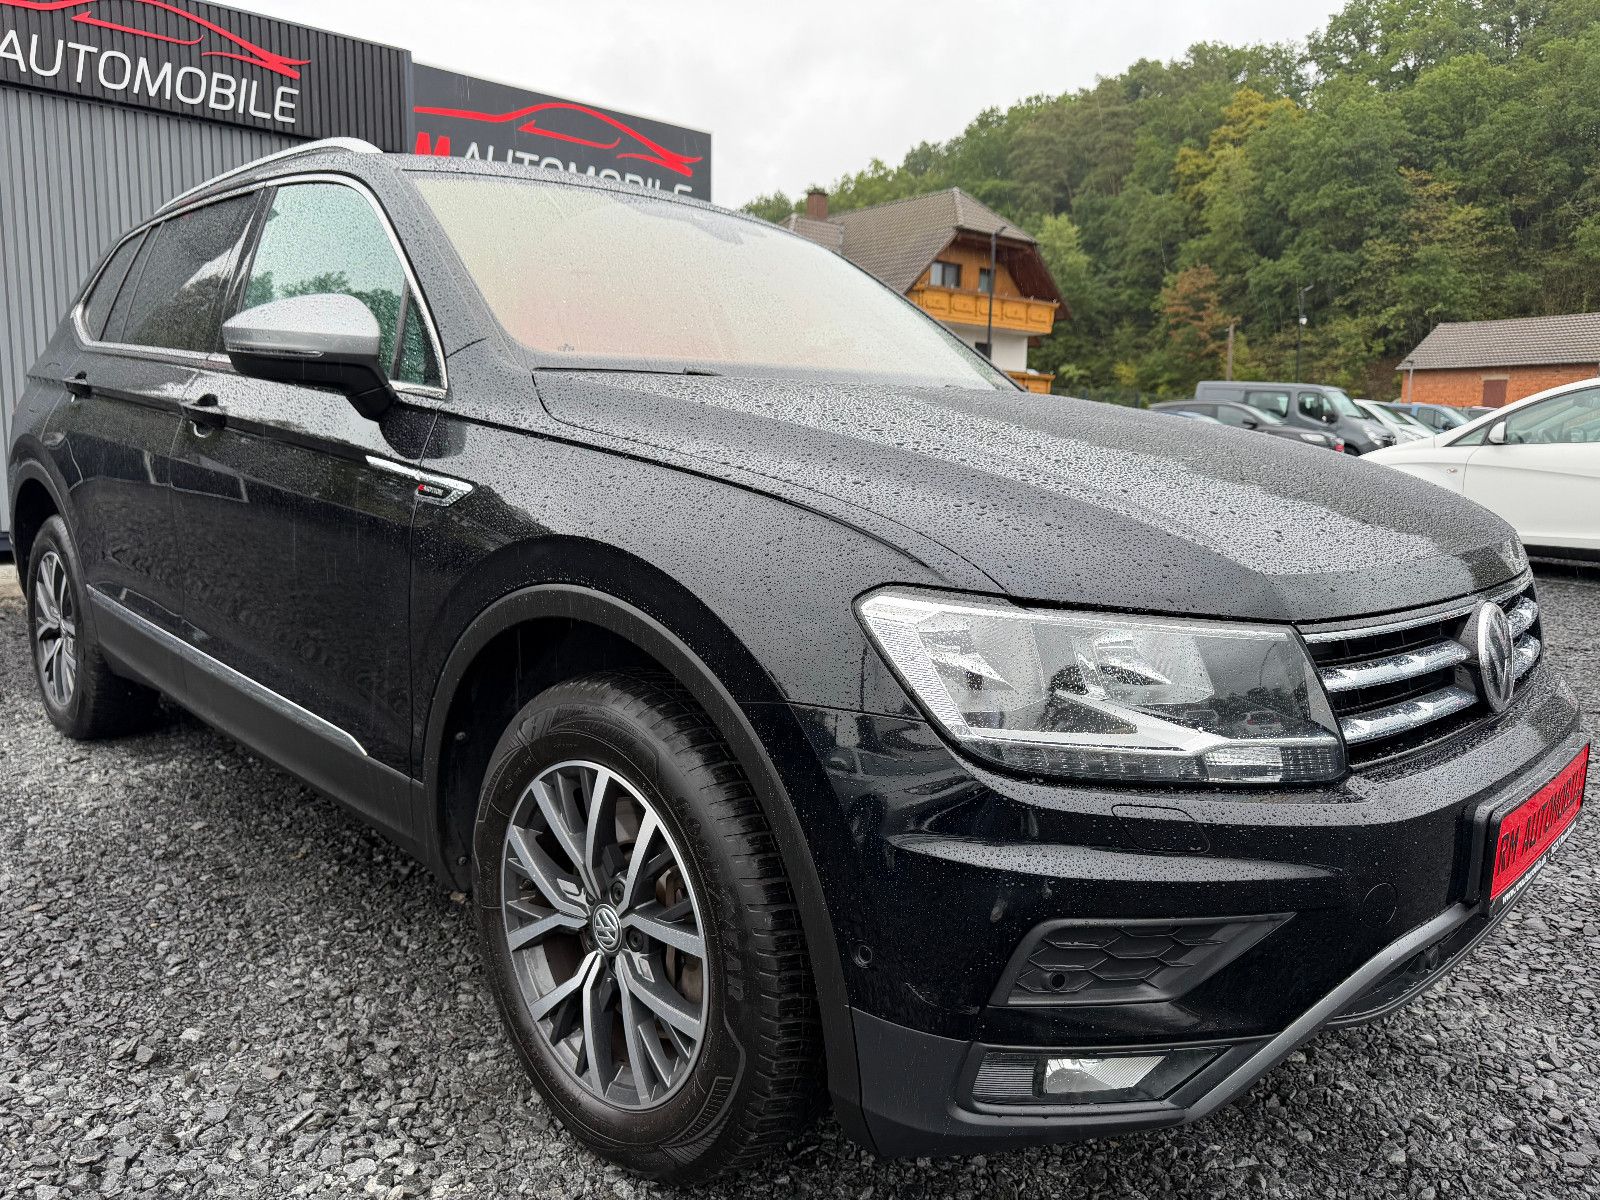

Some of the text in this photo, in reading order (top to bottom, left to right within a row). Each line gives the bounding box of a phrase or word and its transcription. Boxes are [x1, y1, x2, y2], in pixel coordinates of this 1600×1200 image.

[0, 29, 300, 123] AUTOMOBILE
[1497, 824, 1520, 877] RM
[594, 906, 620, 949] VW
